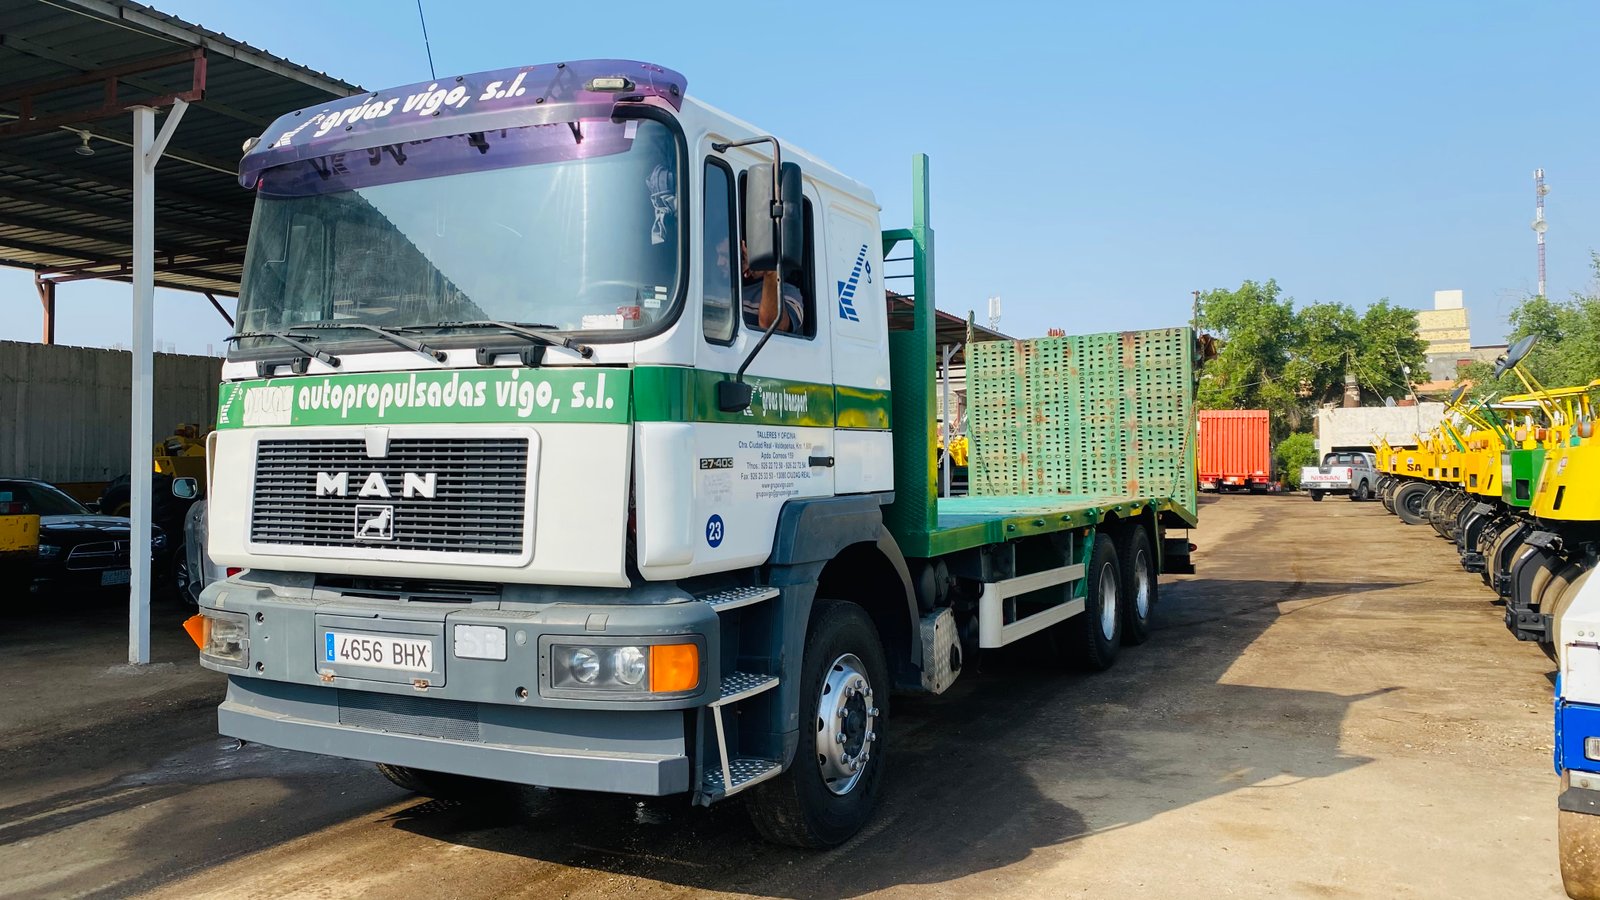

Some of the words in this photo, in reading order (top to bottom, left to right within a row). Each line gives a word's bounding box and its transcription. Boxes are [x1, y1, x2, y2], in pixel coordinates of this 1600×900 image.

[314, 96, 399, 138] grúas
[402, 83, 471, 116] vigo,
[479, 72, 528, 101] s.l.
[298, 372, 487, 418] autopropulsadas
[496, 368, 560, 418] vigo,
[571, 373, 614, 409] s.l.
[748, 441, 763, 449] Ciudad
[763, 441, 772, 449] Real
[757, 431, 777, 439] TALLERES
[781, 431, 796, 439] OFICINA
[772, 452, 787, 460] Correos
[316, 472, 438, 499] MAN
[708, 521, 721, 541] 23
[340, 638, 383, 663] 4656
[393, 642, 427, 668] BHX
